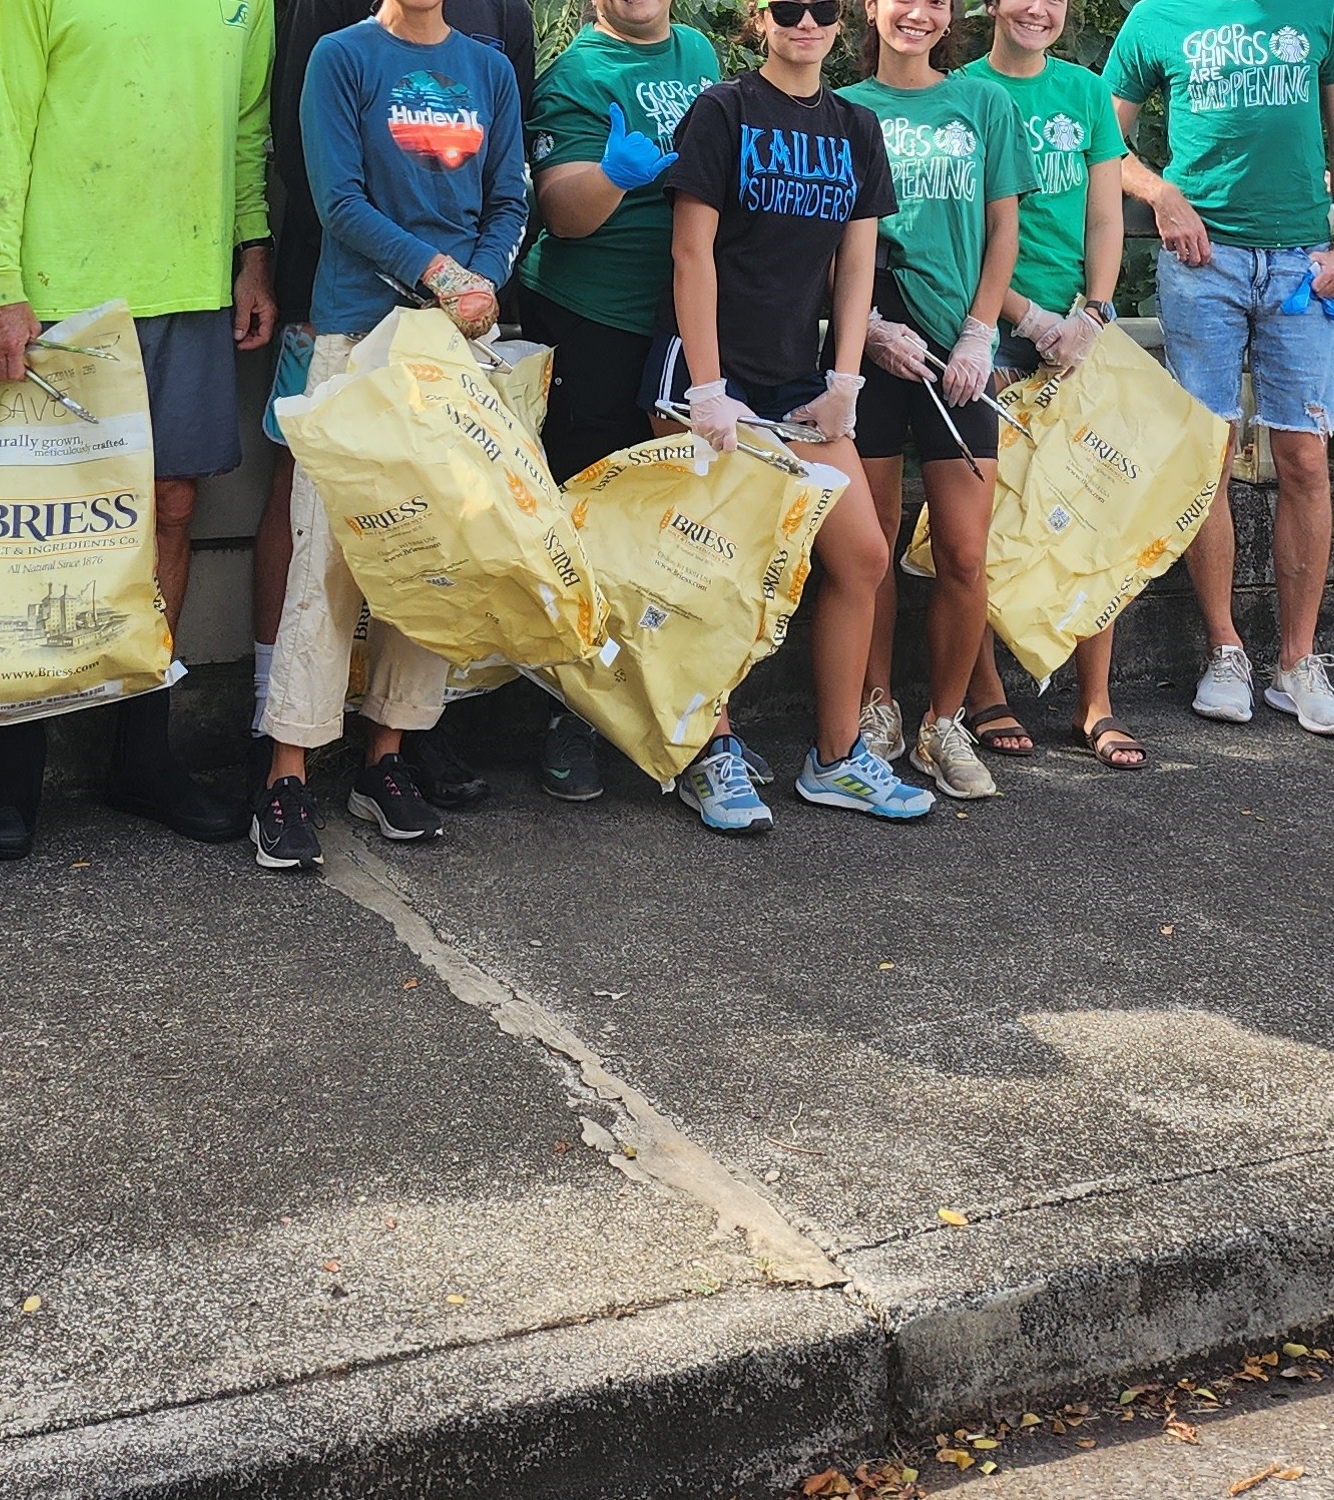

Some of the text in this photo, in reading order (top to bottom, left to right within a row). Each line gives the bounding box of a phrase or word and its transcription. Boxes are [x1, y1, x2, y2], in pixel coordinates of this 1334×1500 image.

[1185, 30, 1268, 69] THINGS
[1187, 64, 1310, 113] HAPPENING
[1189, 66, 1224, 83] ARE
[389, 105, 459, 127] Hurley
[739, 123, 857, 193] KAILUA
[890, 155, 977, 202] PENING
[748, 177, 853, 223] SURFRIDERS
[34, 438, 129, 457] meticulously crafted.
[41, 436, 84, 450] grown,
[628, 444, 695, 466] BRIESS
[1083, 431, 1141, 480] BRIESS
[354, 495, 429, 529] BRIESS
[1175, 480, 1218, 533] BRIESS
[13, 547, 23, 555] &
[28, 538, 116, 555] INGREDIENTS
[119, 536, 139, 545] Co.
[671, 513, 737, 560] BRIESS
[7, 555, 104, 574] All Natural Since 1876
[543, 526, 582, 588] BRIESS
[762, 549, 788, 601] BRIESS
[1, 660, 100, 680] www.Briess.com
